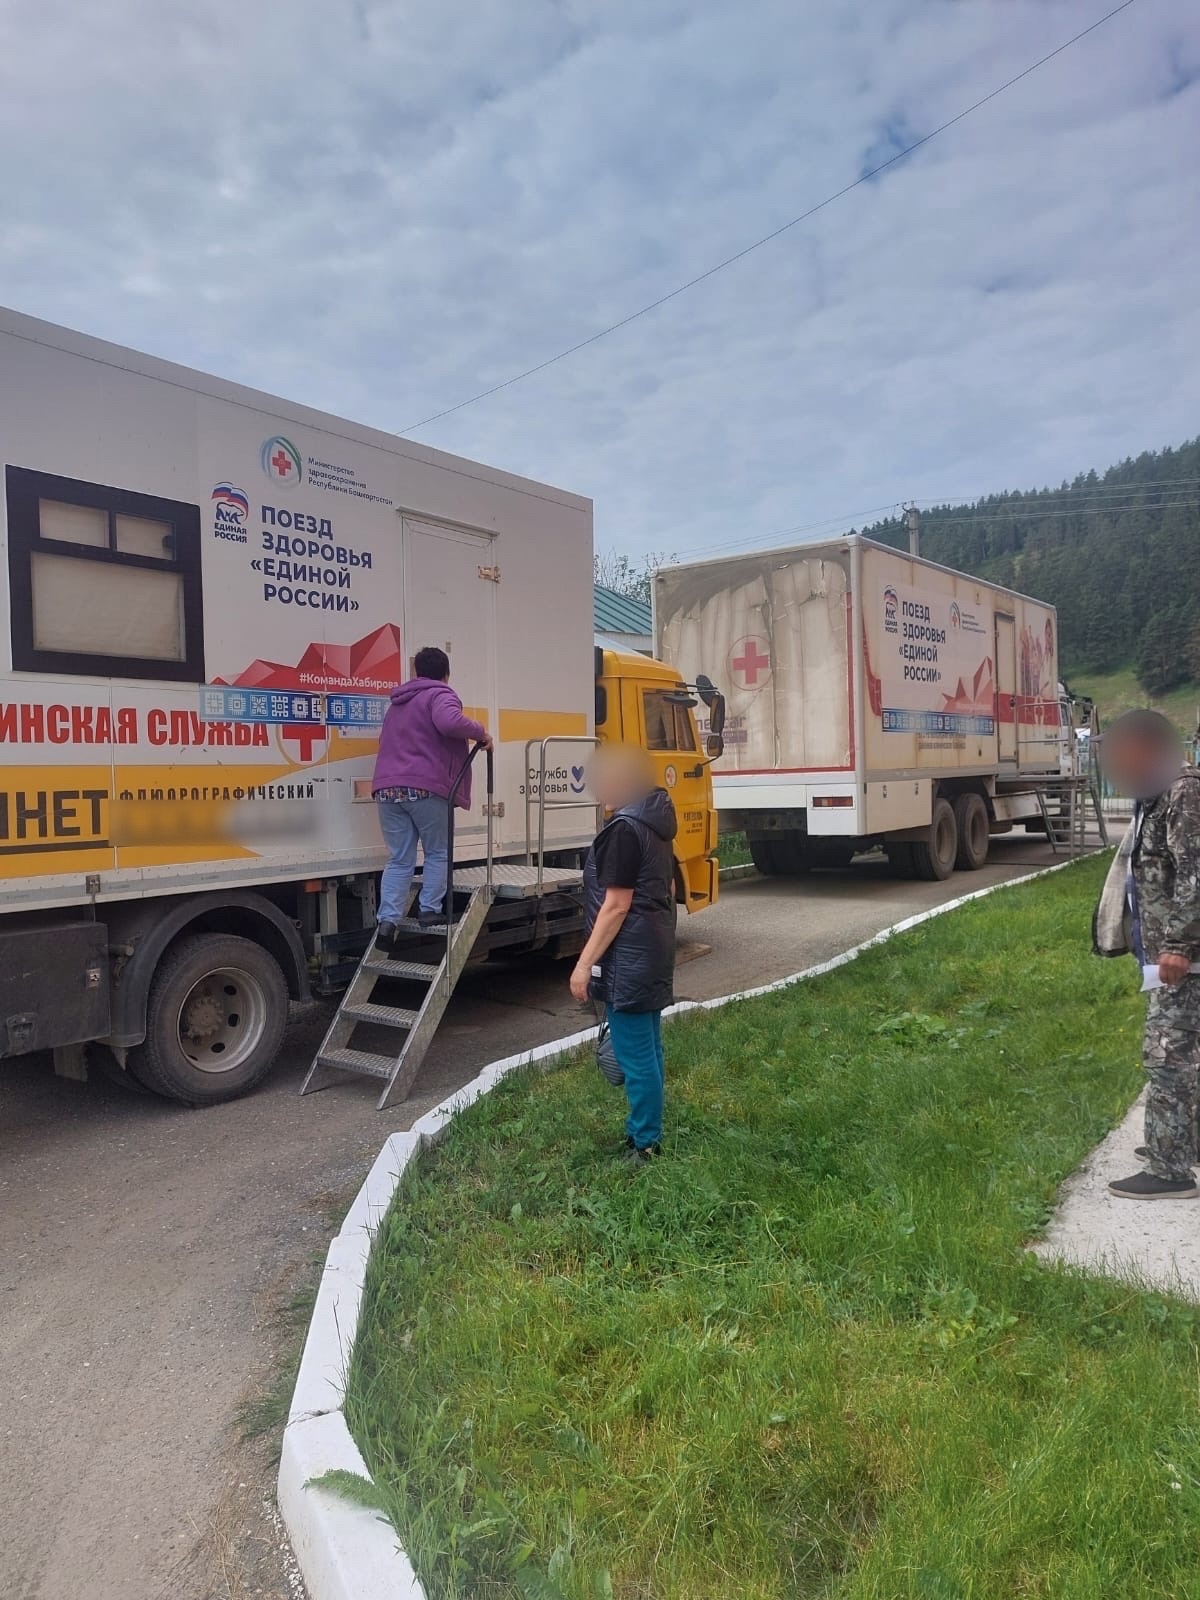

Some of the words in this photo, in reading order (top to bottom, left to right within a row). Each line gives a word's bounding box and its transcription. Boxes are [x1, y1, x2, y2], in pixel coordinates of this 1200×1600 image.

[214, 522, 247, 535] ЕДИНАЯ
[261, 504, 334, 541] ПОЕЗД
[214, 531, 248, 544] РОССИЯ
[262, 531, 373, 569] ЗДОРОВЬЯ
[250, 557, 351, 589] «ЕДИНОЙ
[263, 583, 360, 613] РОССИИ»
[902, 600, 931, 624] ПОЕЗД
[903, 622, 946, 644] ЗДОРОВЬЯ
[899, 643, 938, 663] «ЕДИНОЙ
[299, 672, 399, 690] #КомандаХабирова
[904, 665, 941, 683] РОССИИ»
[0, 703, 139, 745] ИНСКАЯ
[0, 789, 109, 840] НЕТ
